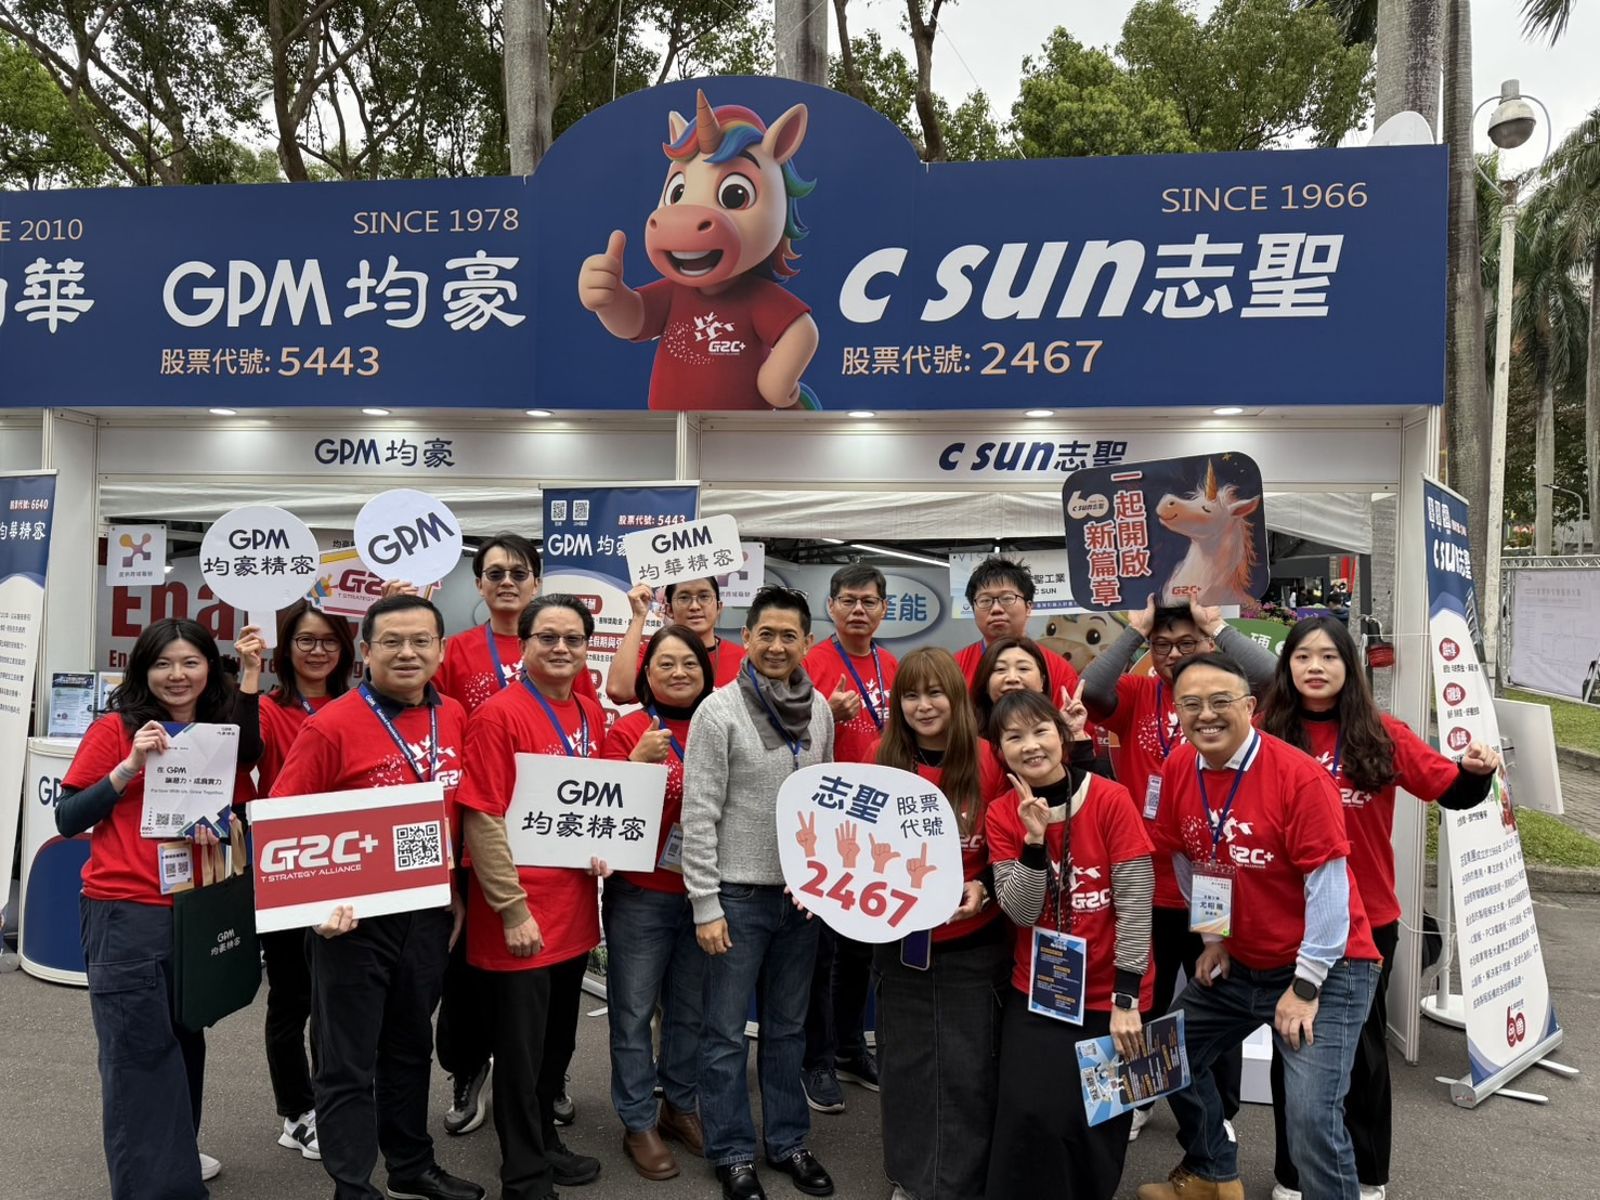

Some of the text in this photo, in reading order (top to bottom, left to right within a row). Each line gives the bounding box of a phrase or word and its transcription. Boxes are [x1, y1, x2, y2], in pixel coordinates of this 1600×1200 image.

[1161, 182, 1369, 213] SINCE 1966
[19, 218, 83, 241] 2010
[353, 208, 520, 235] SINCE 1978
[0, 257, 95, 333] 華
[162, 249, 526, 331] GPM 均豪
[277, 346, 381, 376] 5443
[980, 340, 1103, 375] 2467
[314, 436, 456, 469] GPM 均豪
[31, 498, 49, 510] 6640
[657, 514, 687, 527] 5443
[1110, 471, 1152, 578] 一起開啟
[228, 528, 290, 551] GPM
[367, 511, 455, 565] GPM
[547, 534, 593, 557] GPM
[651, 525, 713, 554] GMM
[203, 554, 317, 577] 均豪精密
[638, 548, 735, 581] 均華精密
[1084, 520, 1122, 607] 新篇章
[1032, 573, 1066, 585] 聖工業
[1040, 587, 1057, 595] SUN
[166, 766, 187, 774] GPM
[557, 779, 624, 809] GPM
[811, 775, 890, 825] 志聖
[896, 793, 940, 816] 股票
[521, 811, 647, 842] 均豪精密
[900, 816, 945, 839] 代號
[268, 870, 317, 883] STRATEGY
[318, 864, 362, 876] ALLIANCE
[799, 860, 919, 928] 2467
[217, 927, 235, 943] GPM
